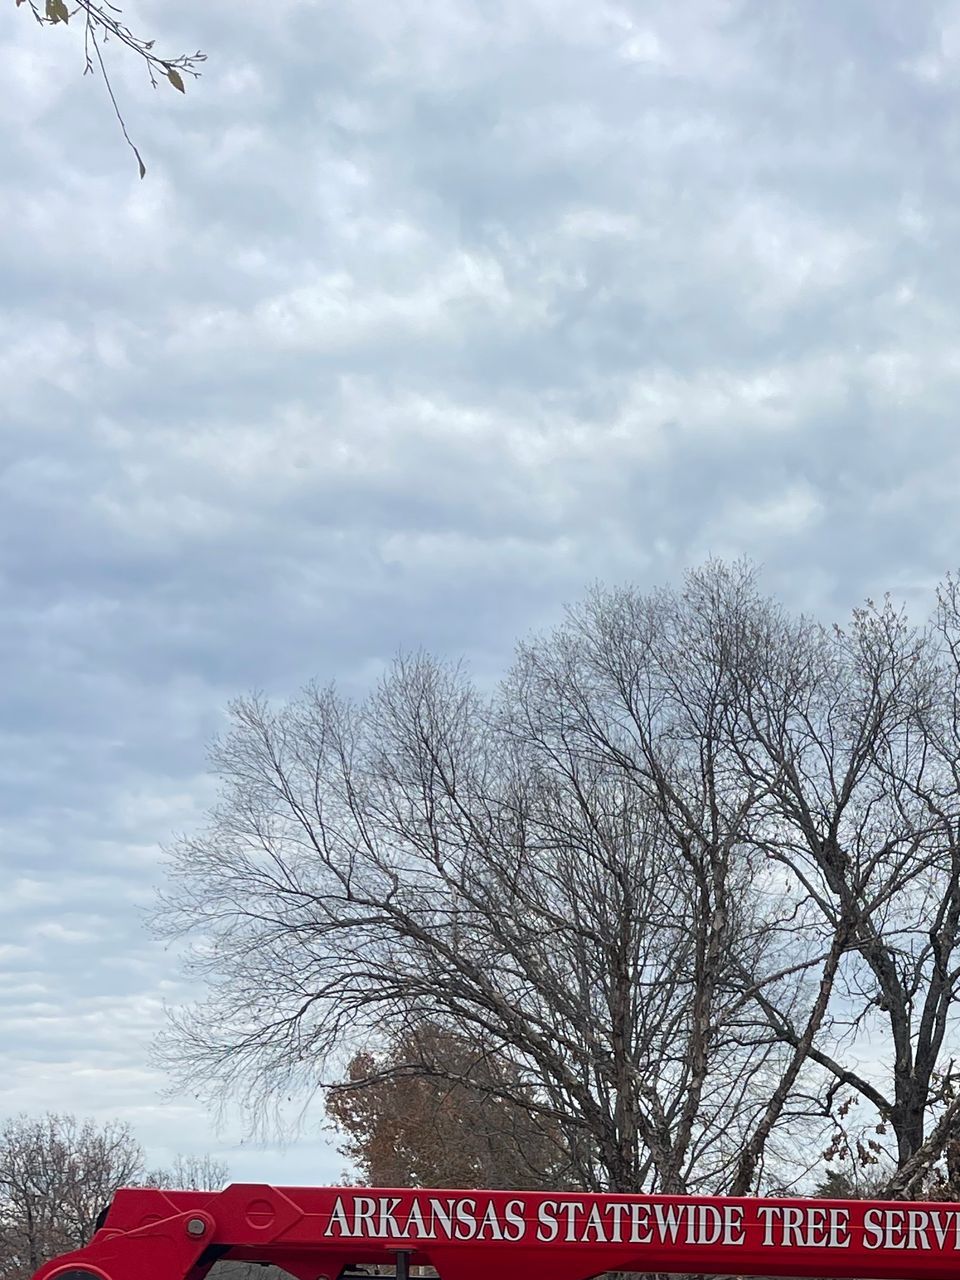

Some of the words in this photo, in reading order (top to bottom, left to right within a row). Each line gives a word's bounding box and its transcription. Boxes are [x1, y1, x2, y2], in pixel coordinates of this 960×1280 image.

[323, 1195, 526, 1242] ARKANSAS
[535, 1200, 746, 1246] STATEWIDE
[757, 1206, 851, 1248] TREE
